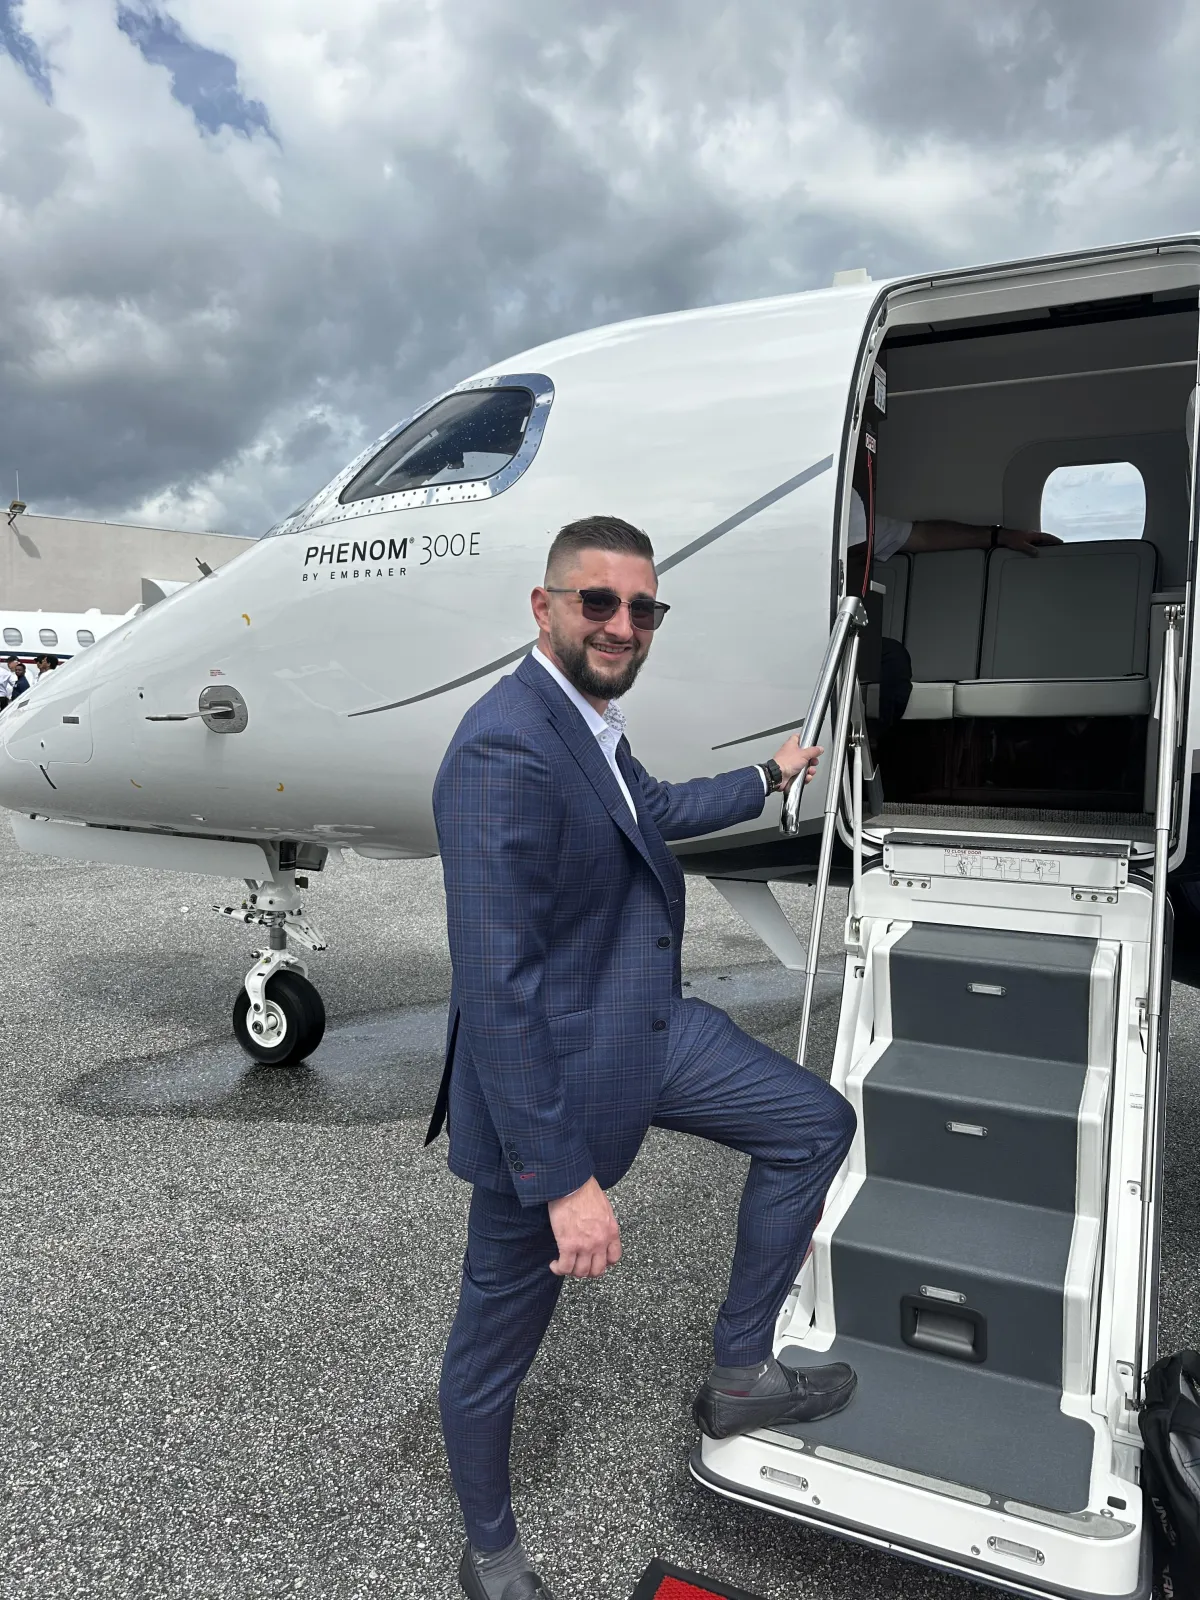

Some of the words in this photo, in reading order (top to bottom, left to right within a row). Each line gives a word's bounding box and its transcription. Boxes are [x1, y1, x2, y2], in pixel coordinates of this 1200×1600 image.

[420, 532, 480, 565] 300E
[303, 573, 318, 581] BY
[330, 568, 407, 579] EMBRAER
